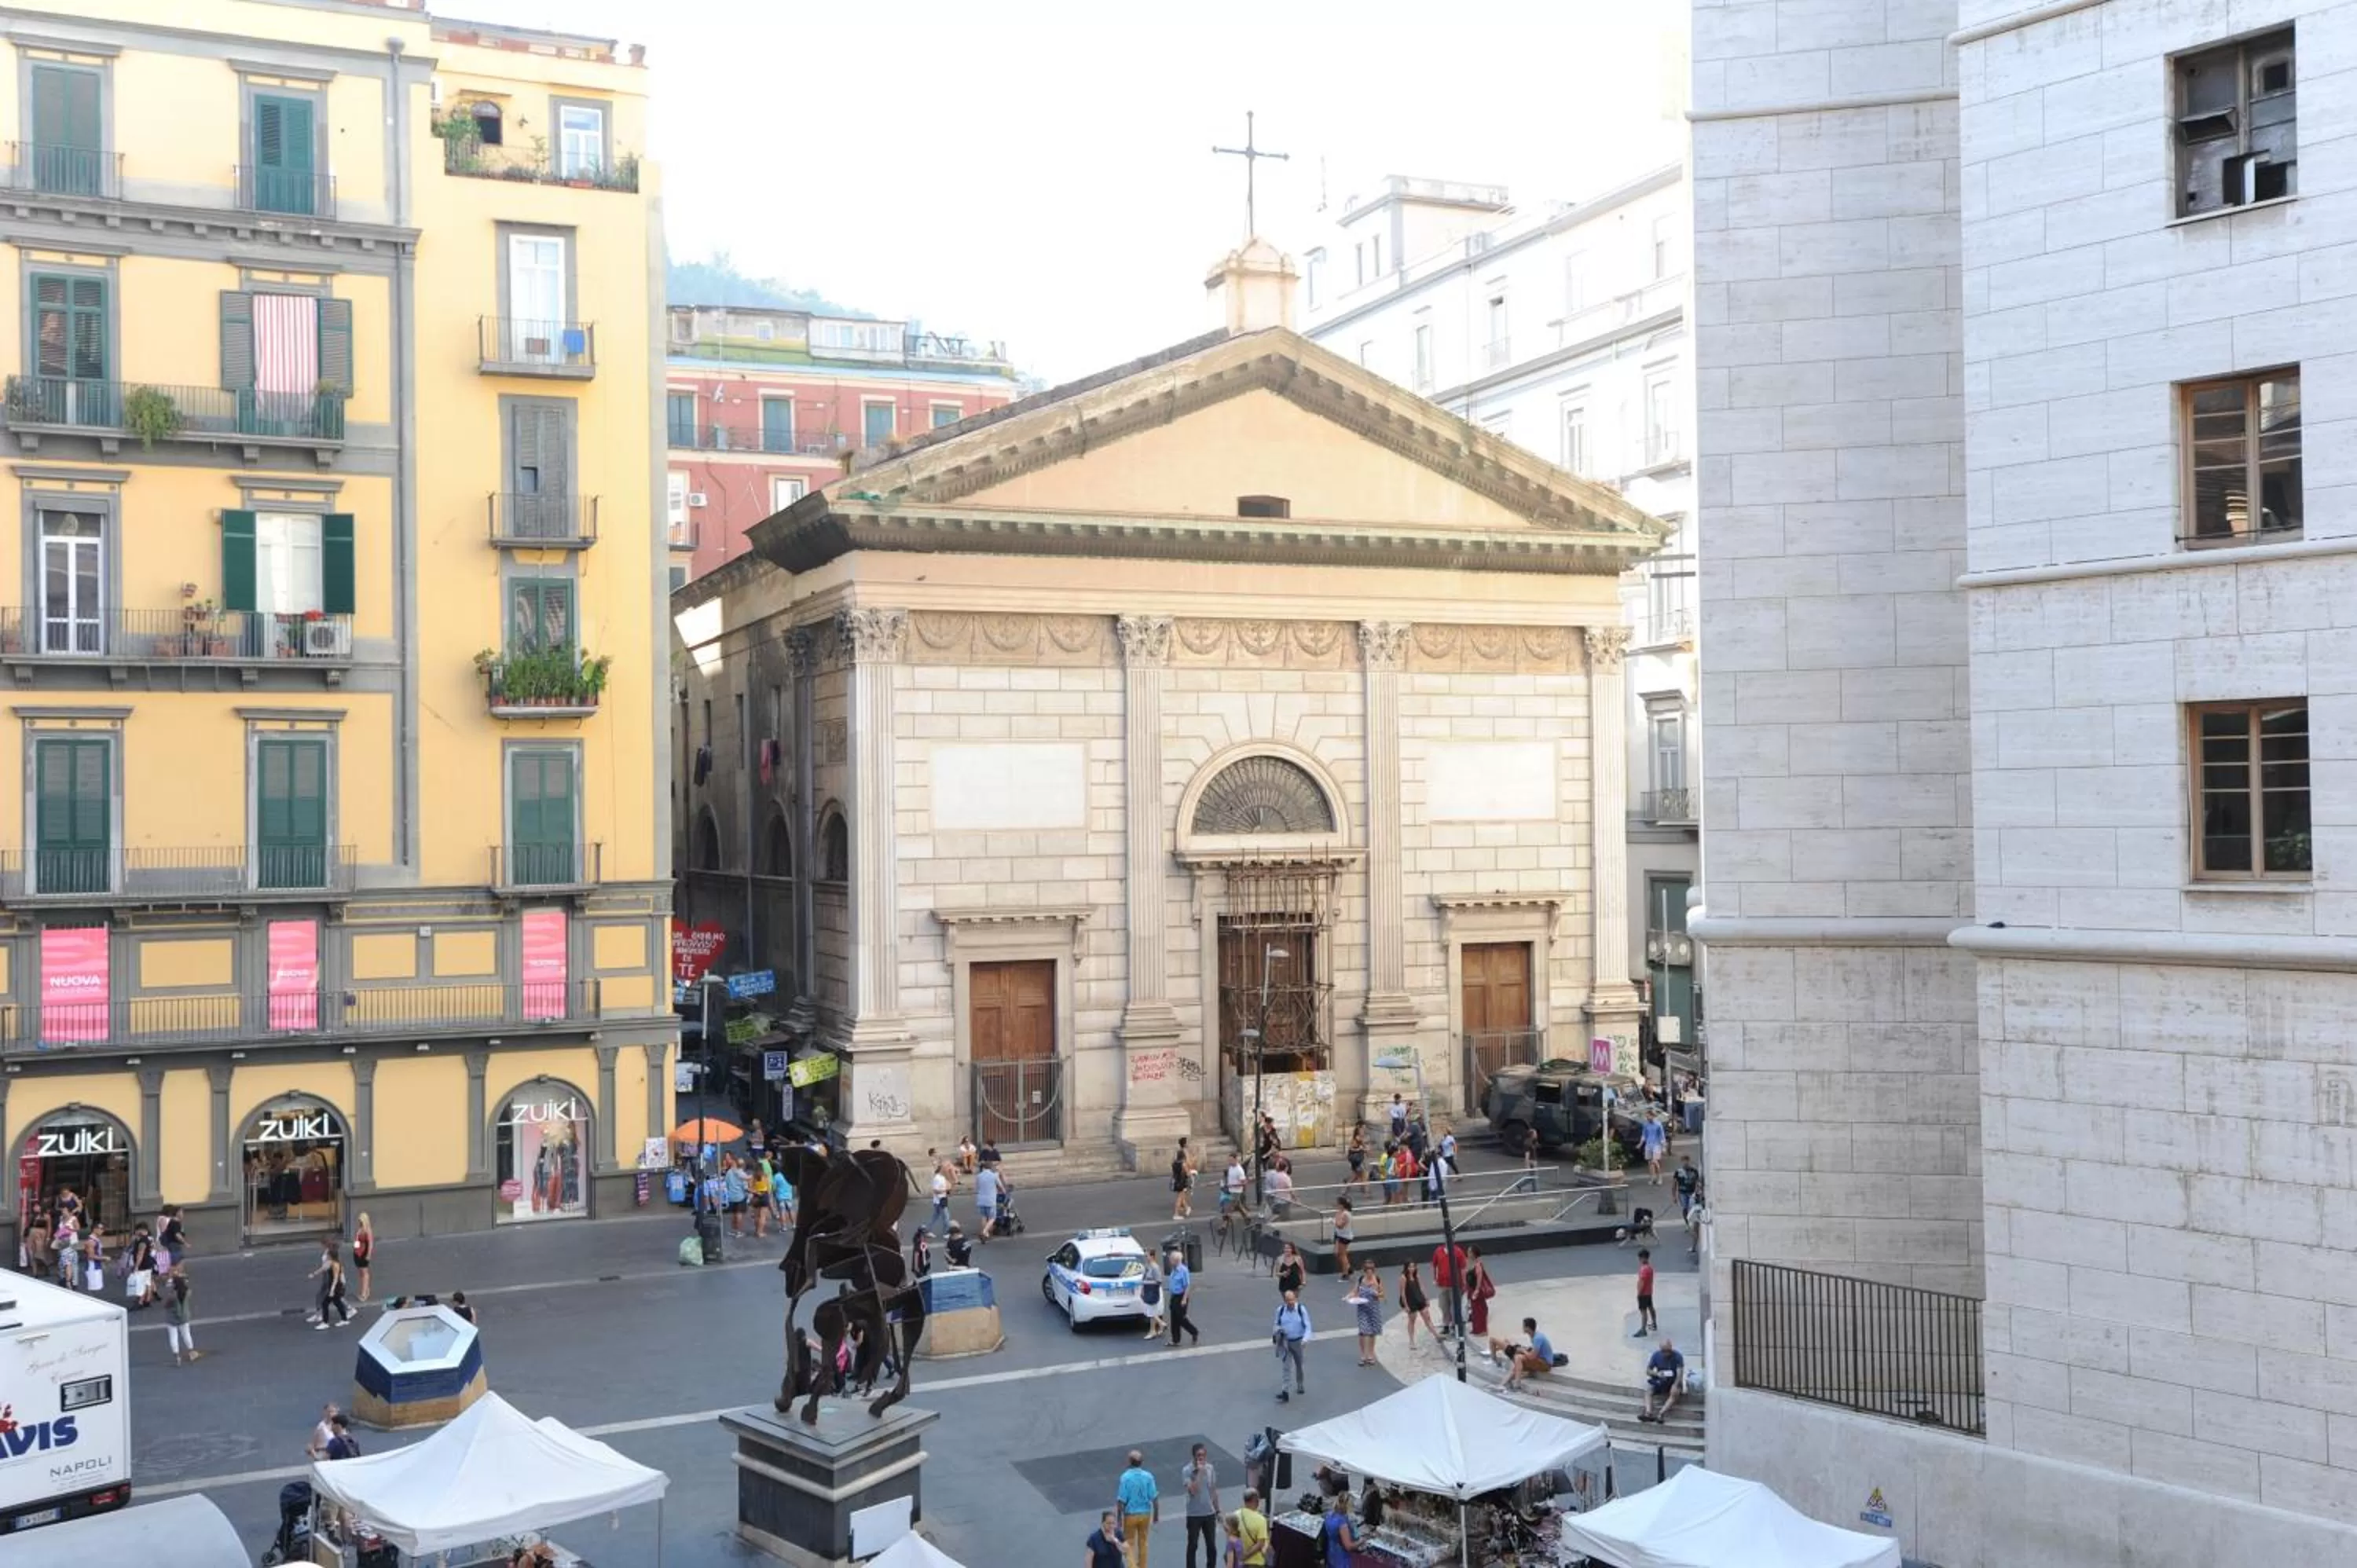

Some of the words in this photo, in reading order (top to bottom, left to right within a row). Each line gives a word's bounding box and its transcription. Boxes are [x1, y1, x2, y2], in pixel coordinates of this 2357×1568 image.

[679, 963, 696, 977] TE
[49, 974, 101, 987] NUOVA
[1594, 1046, 1608, 1066] M
[50, 1455, 112, 1478] NAPOLI
